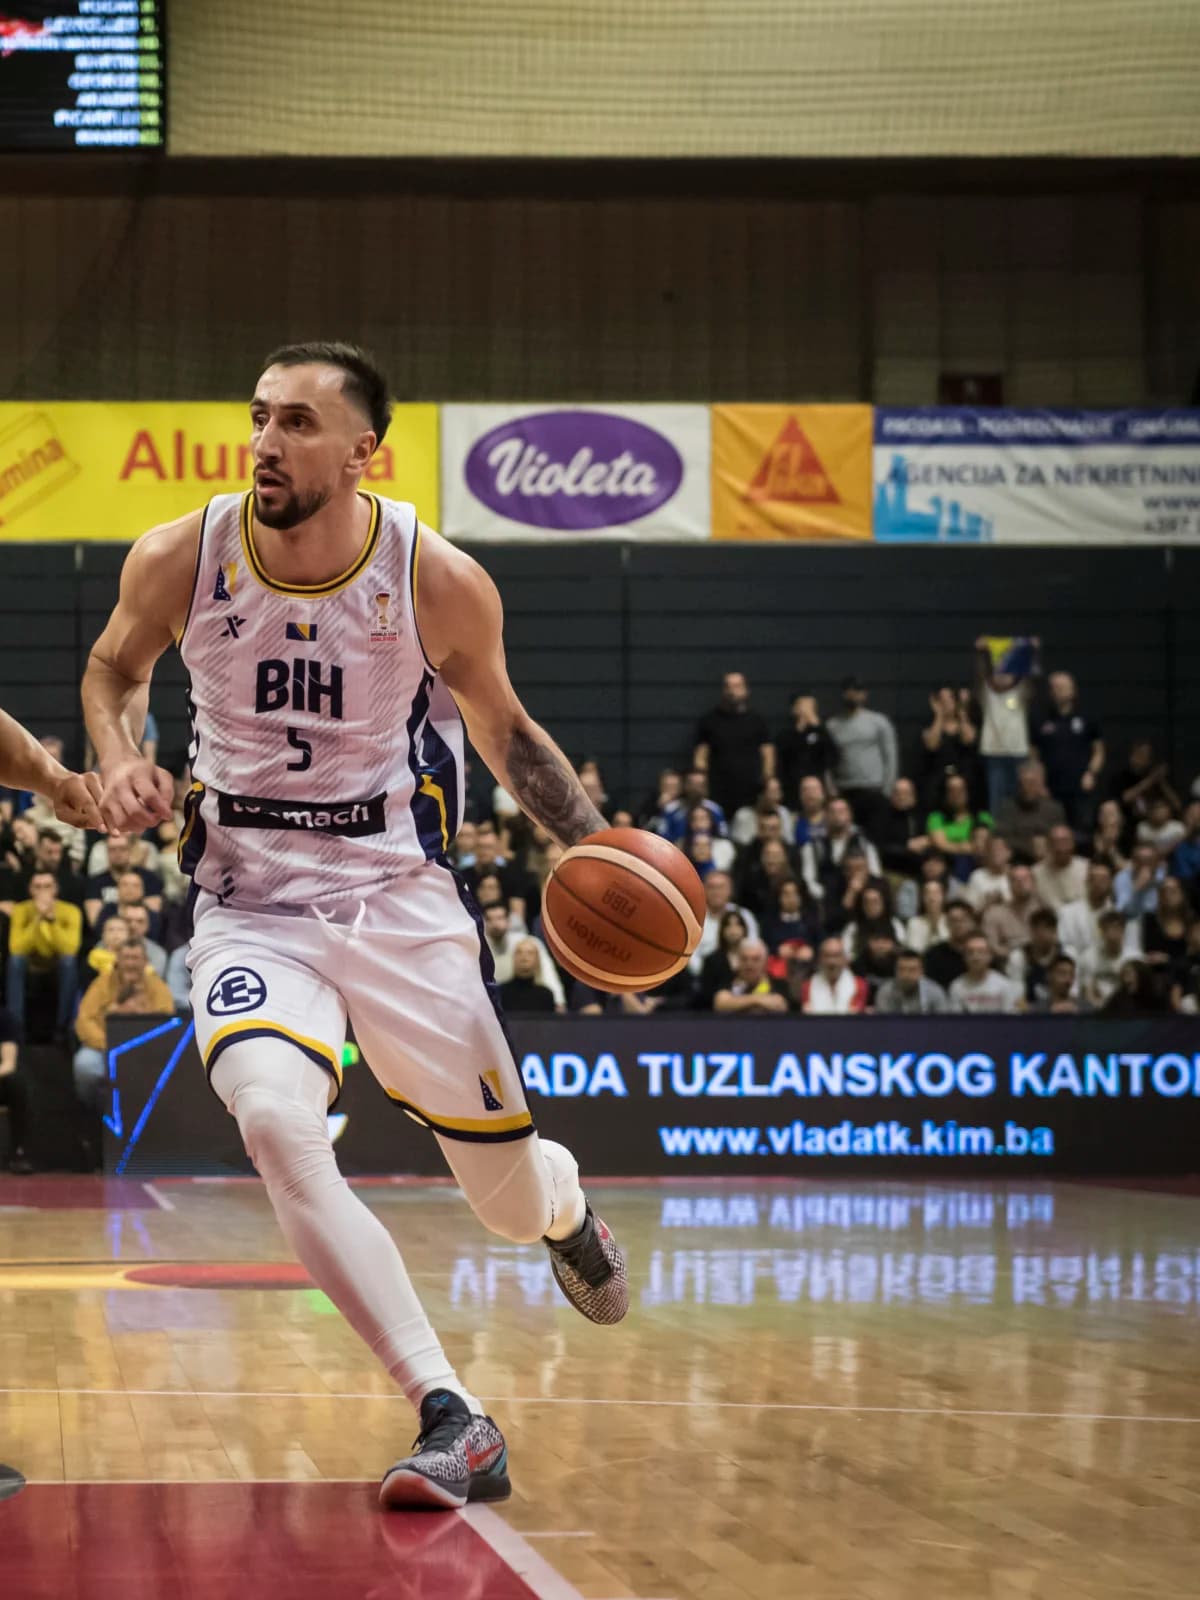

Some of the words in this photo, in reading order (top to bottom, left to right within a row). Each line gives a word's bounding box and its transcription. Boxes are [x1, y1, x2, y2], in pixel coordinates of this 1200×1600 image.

[487, 437, 658, 496] Violeta
[1054, 464, 1200, 486] NEKRETNIN
[255, 658, 343, 719] BIH
[286, 727, 312, 772] 5
[567, 915, 632, 963] molten
[638, 1053, 995, 1096] TUZLANSKOG
[1010, 1053, 1200, 1096] KANTO
[659, 1121, 1054, 1155] www.vladatk.kim.ba
